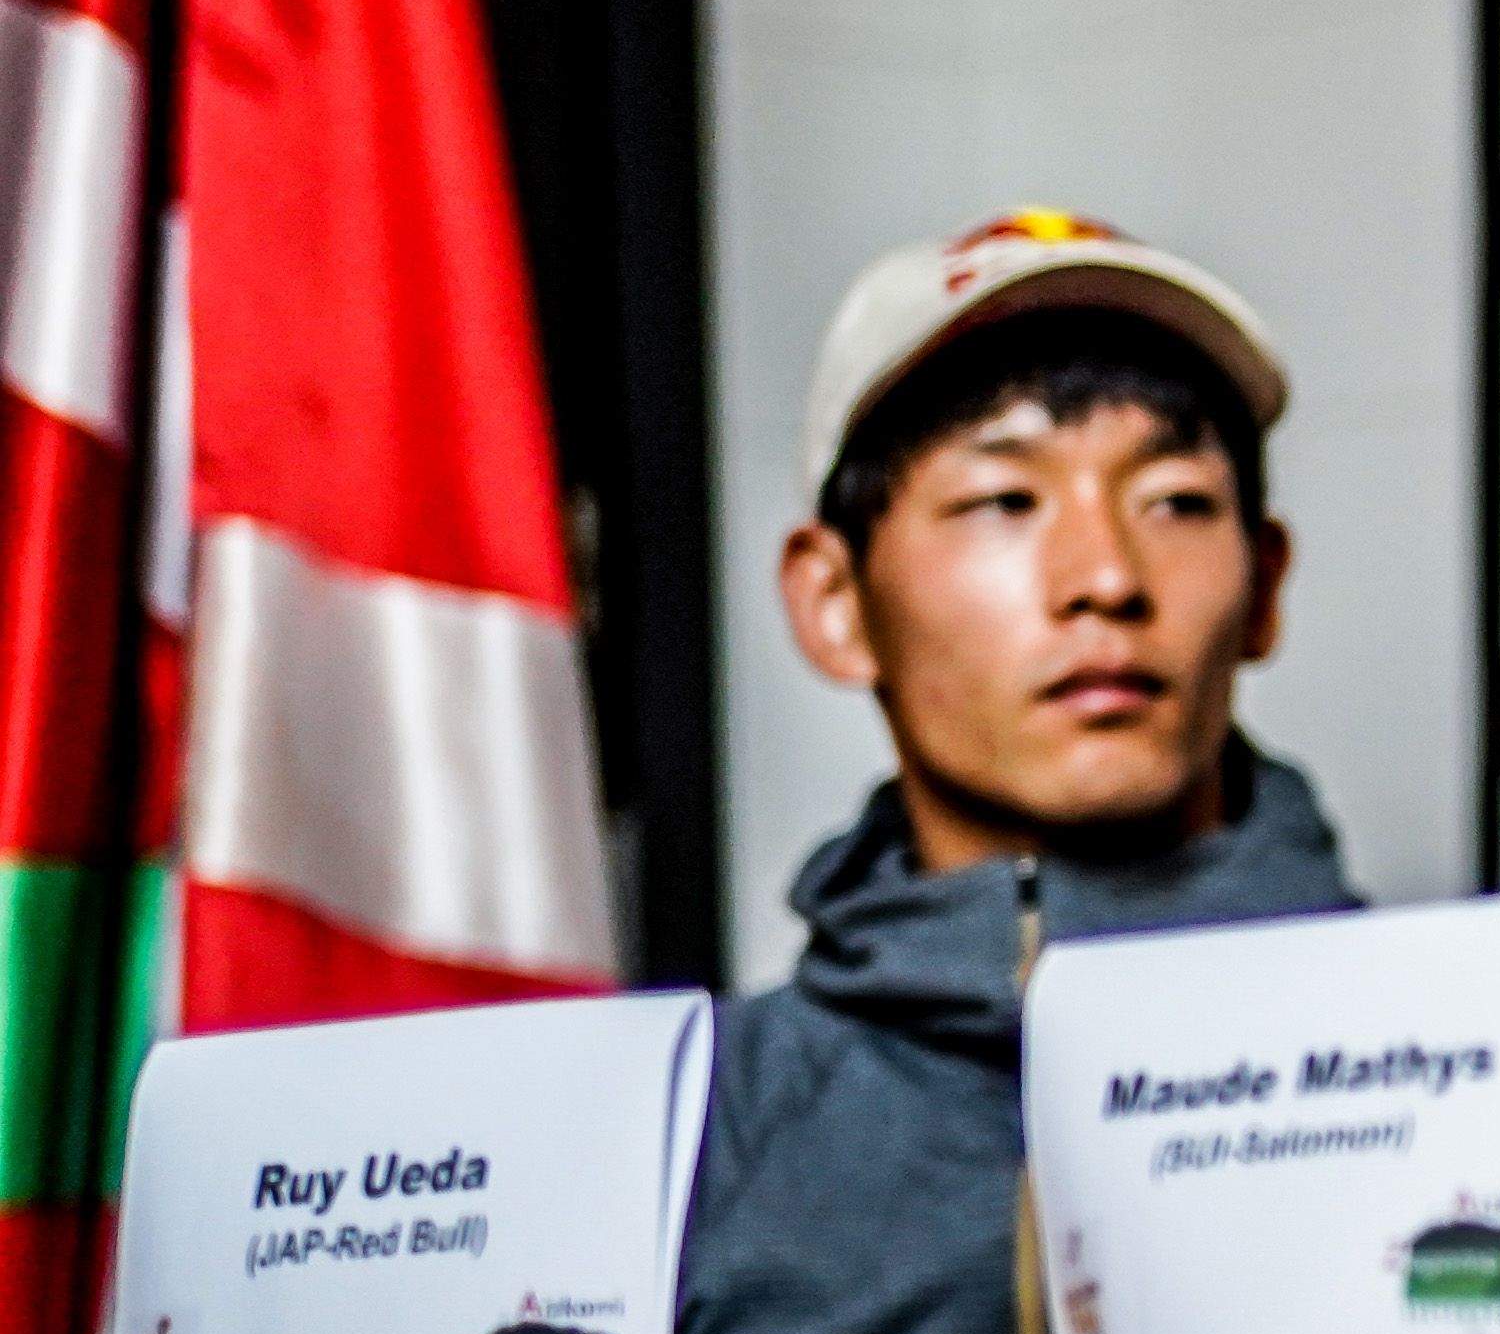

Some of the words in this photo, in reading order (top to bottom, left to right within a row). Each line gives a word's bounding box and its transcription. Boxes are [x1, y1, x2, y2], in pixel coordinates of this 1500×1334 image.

[1103, 1055, 1280, 1122] Maude
[1297, 1041, 1497, 1097] Mathys
[251, 1162, 348, 1216] Ruy
[362, 1145, 491, 1199] Ueda
[245, 1220, 403, 1280] (JAP-Red
[408, 1215, 489, 1257] Bull)
